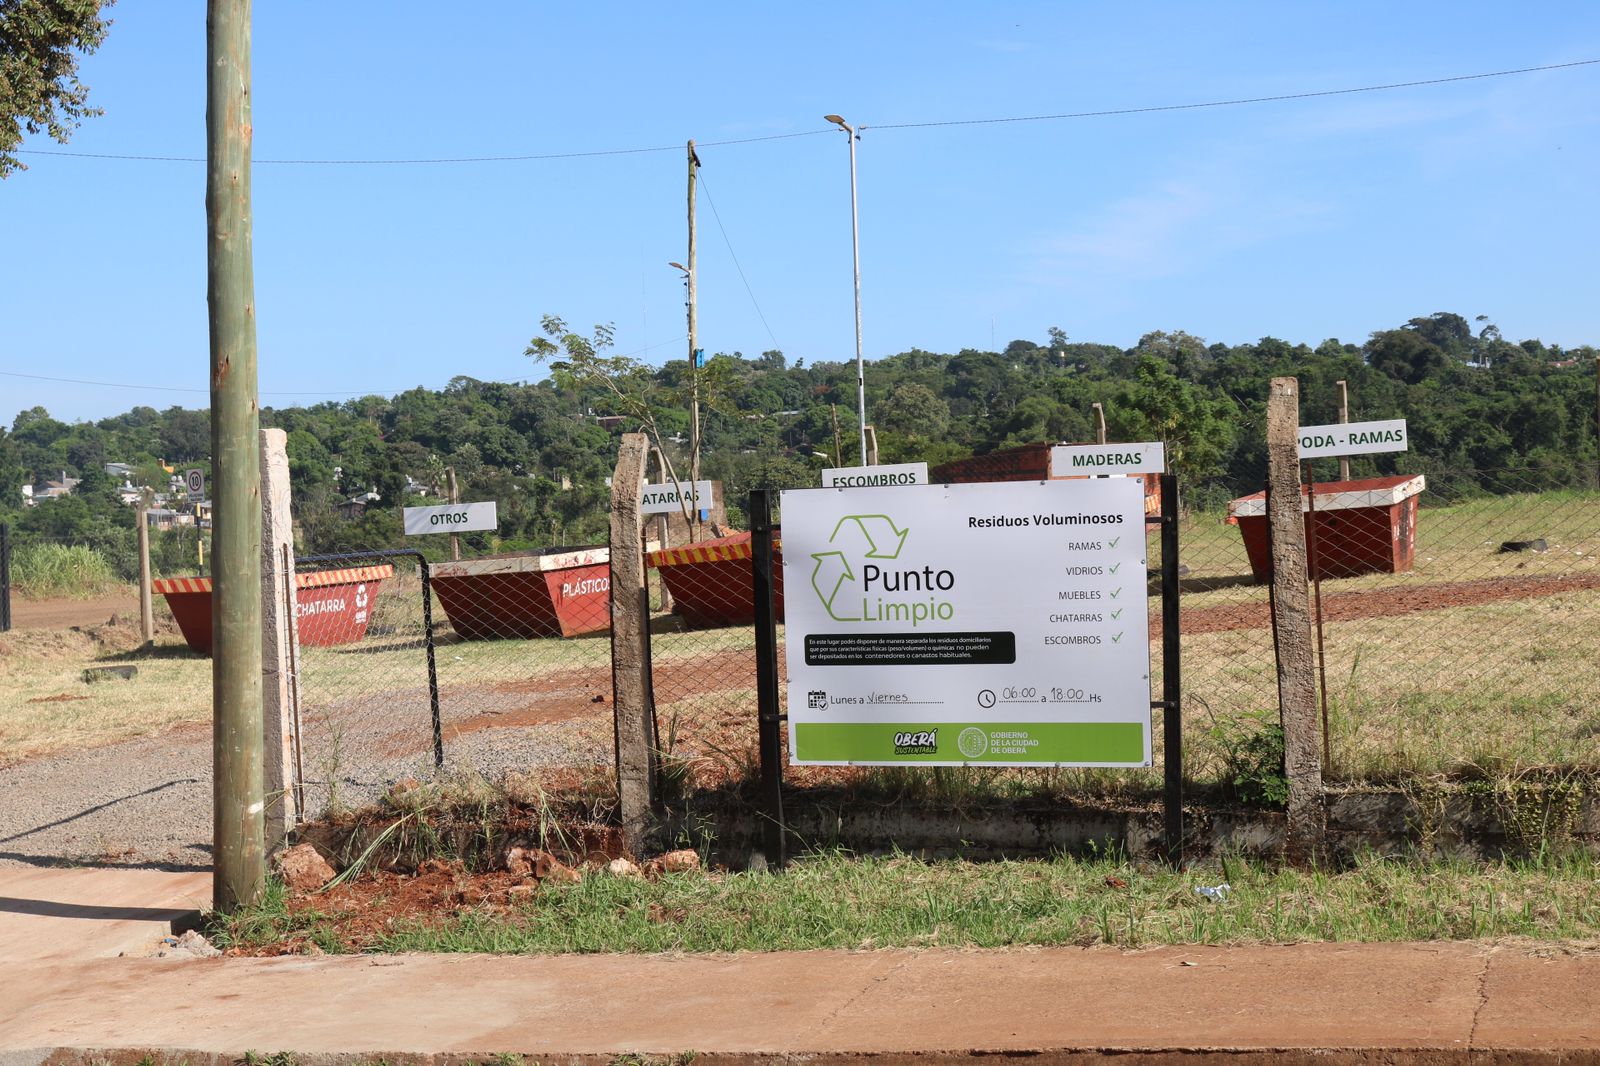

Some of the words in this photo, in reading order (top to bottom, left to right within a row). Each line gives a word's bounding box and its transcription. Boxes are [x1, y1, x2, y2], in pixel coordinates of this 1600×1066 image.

[1298, 434, 1335, 448] ODA
[1349, 430, 1402, 445] RAMAS
[1072, 452, 1142, 466] MADERAS
[192, 476, 199, 486] 10
[832, 472, 916, 488] ESCOMBROS
[430, 512, 468, 526] OTROS
[968, 516, 1030, 528] Residuos
[1033, 513, 1123, 526] Voluminosos
[1068, 542, 1102, 550] RAMAS
[864, 564, 954, 592] Punto
[1066, 566, 1103, 576] VIDRIOS
[1058, 590, 1101, 600] MUEBLES
[296, 598, 346, 617] CHATARRA
[864, 596, 954, 627] Limpio
[1050, 614, 1102, 622] CHATARRAS
[1044, 636, 1102, 645] ESCOMBROS
[830, 695, 856, 704] Lunes
[867, 692, 908, 703] Viernes
[1002, 686, 1036, 699] 06:00
[1050, 687, 1084, 700] 18:00
[1090, 694, 1102, 702] Hs
[894, 728, 938, 746] OBERÁ
[895, 746, 937, 755] SUSTENTABLE
